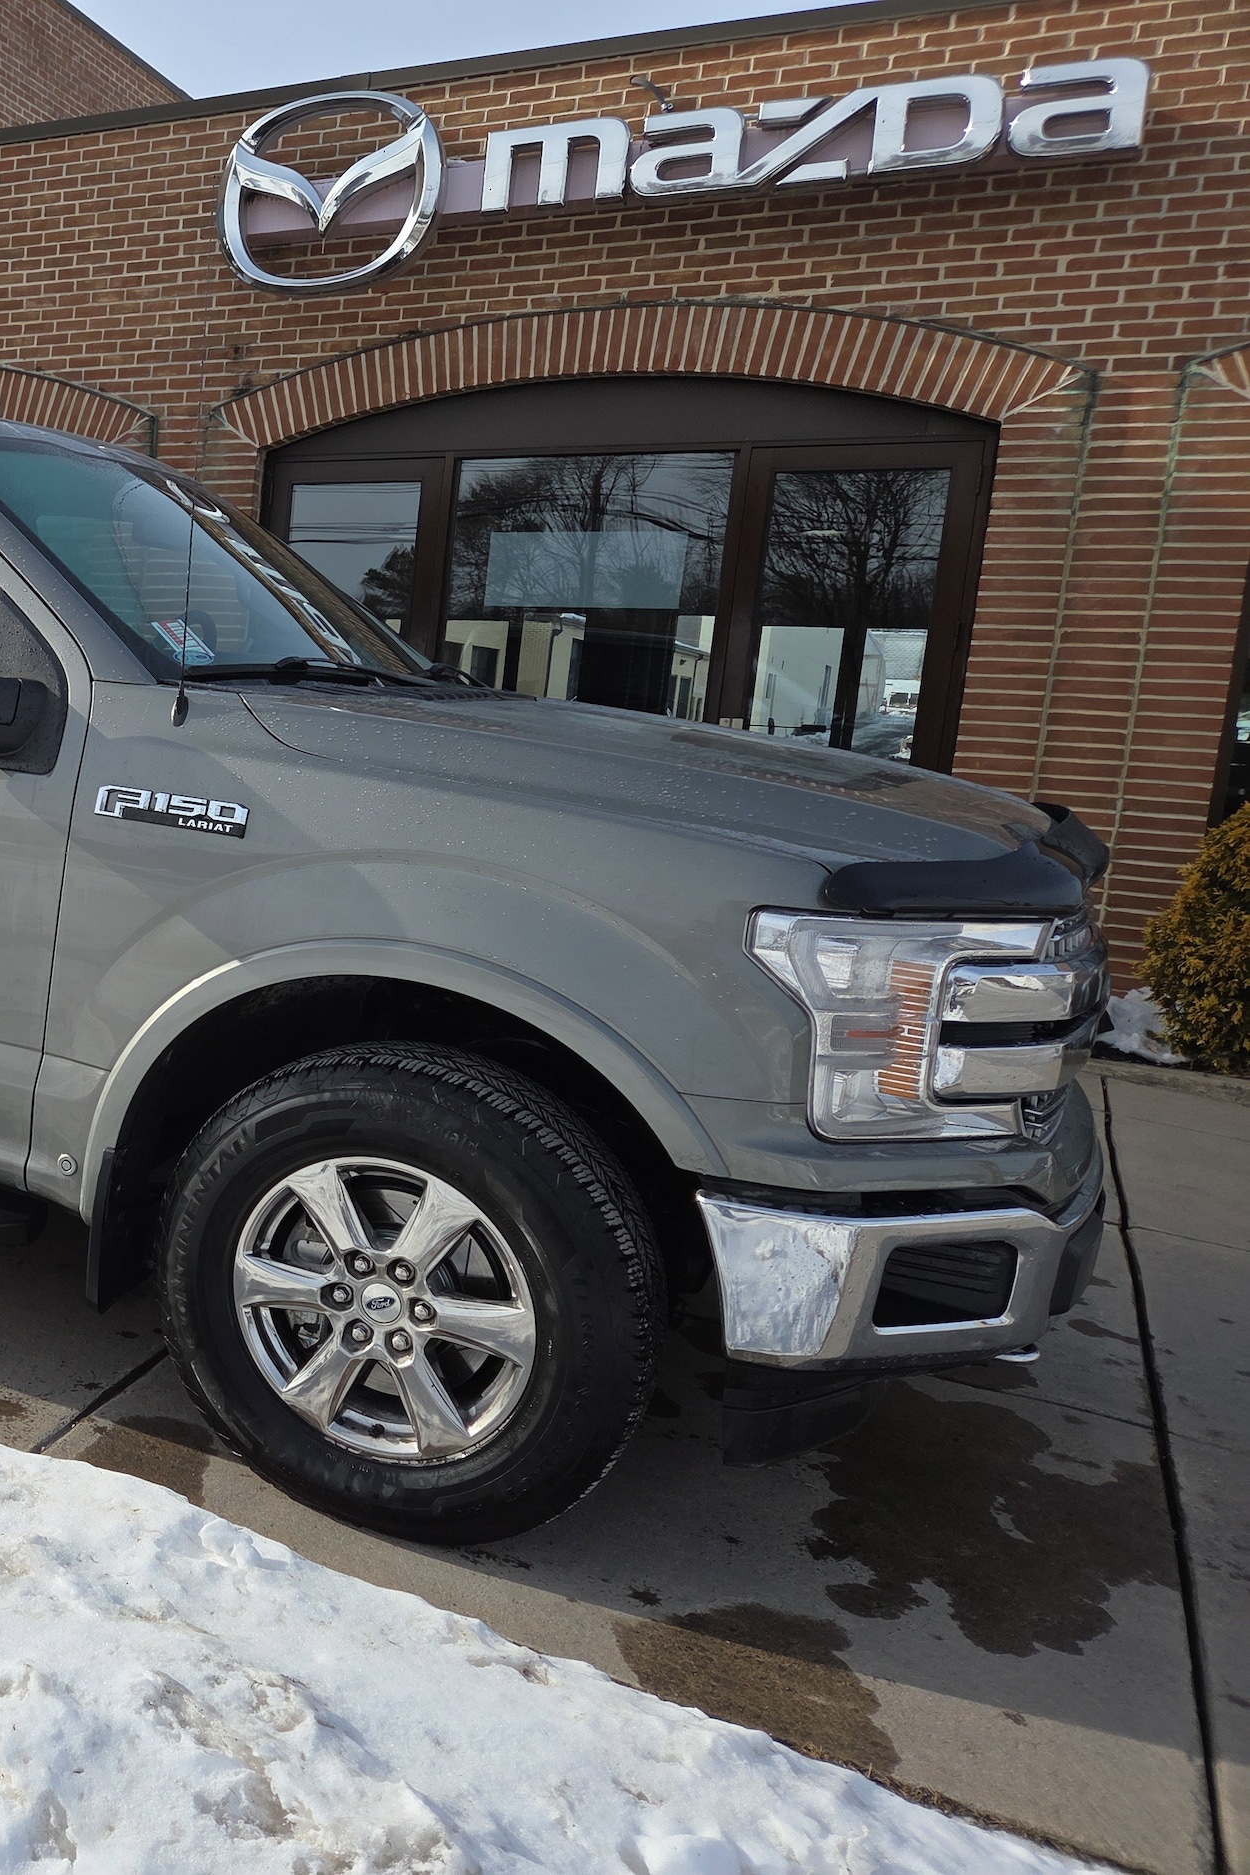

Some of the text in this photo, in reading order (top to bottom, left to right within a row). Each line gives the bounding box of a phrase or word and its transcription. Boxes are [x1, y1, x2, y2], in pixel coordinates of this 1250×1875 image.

[480, 57, 1152, 215] mazda
[94, 784, 250, 825] F150
[178, 817, 234, 834] LARIAT
[371, 1298, 391, 1310] Ford
